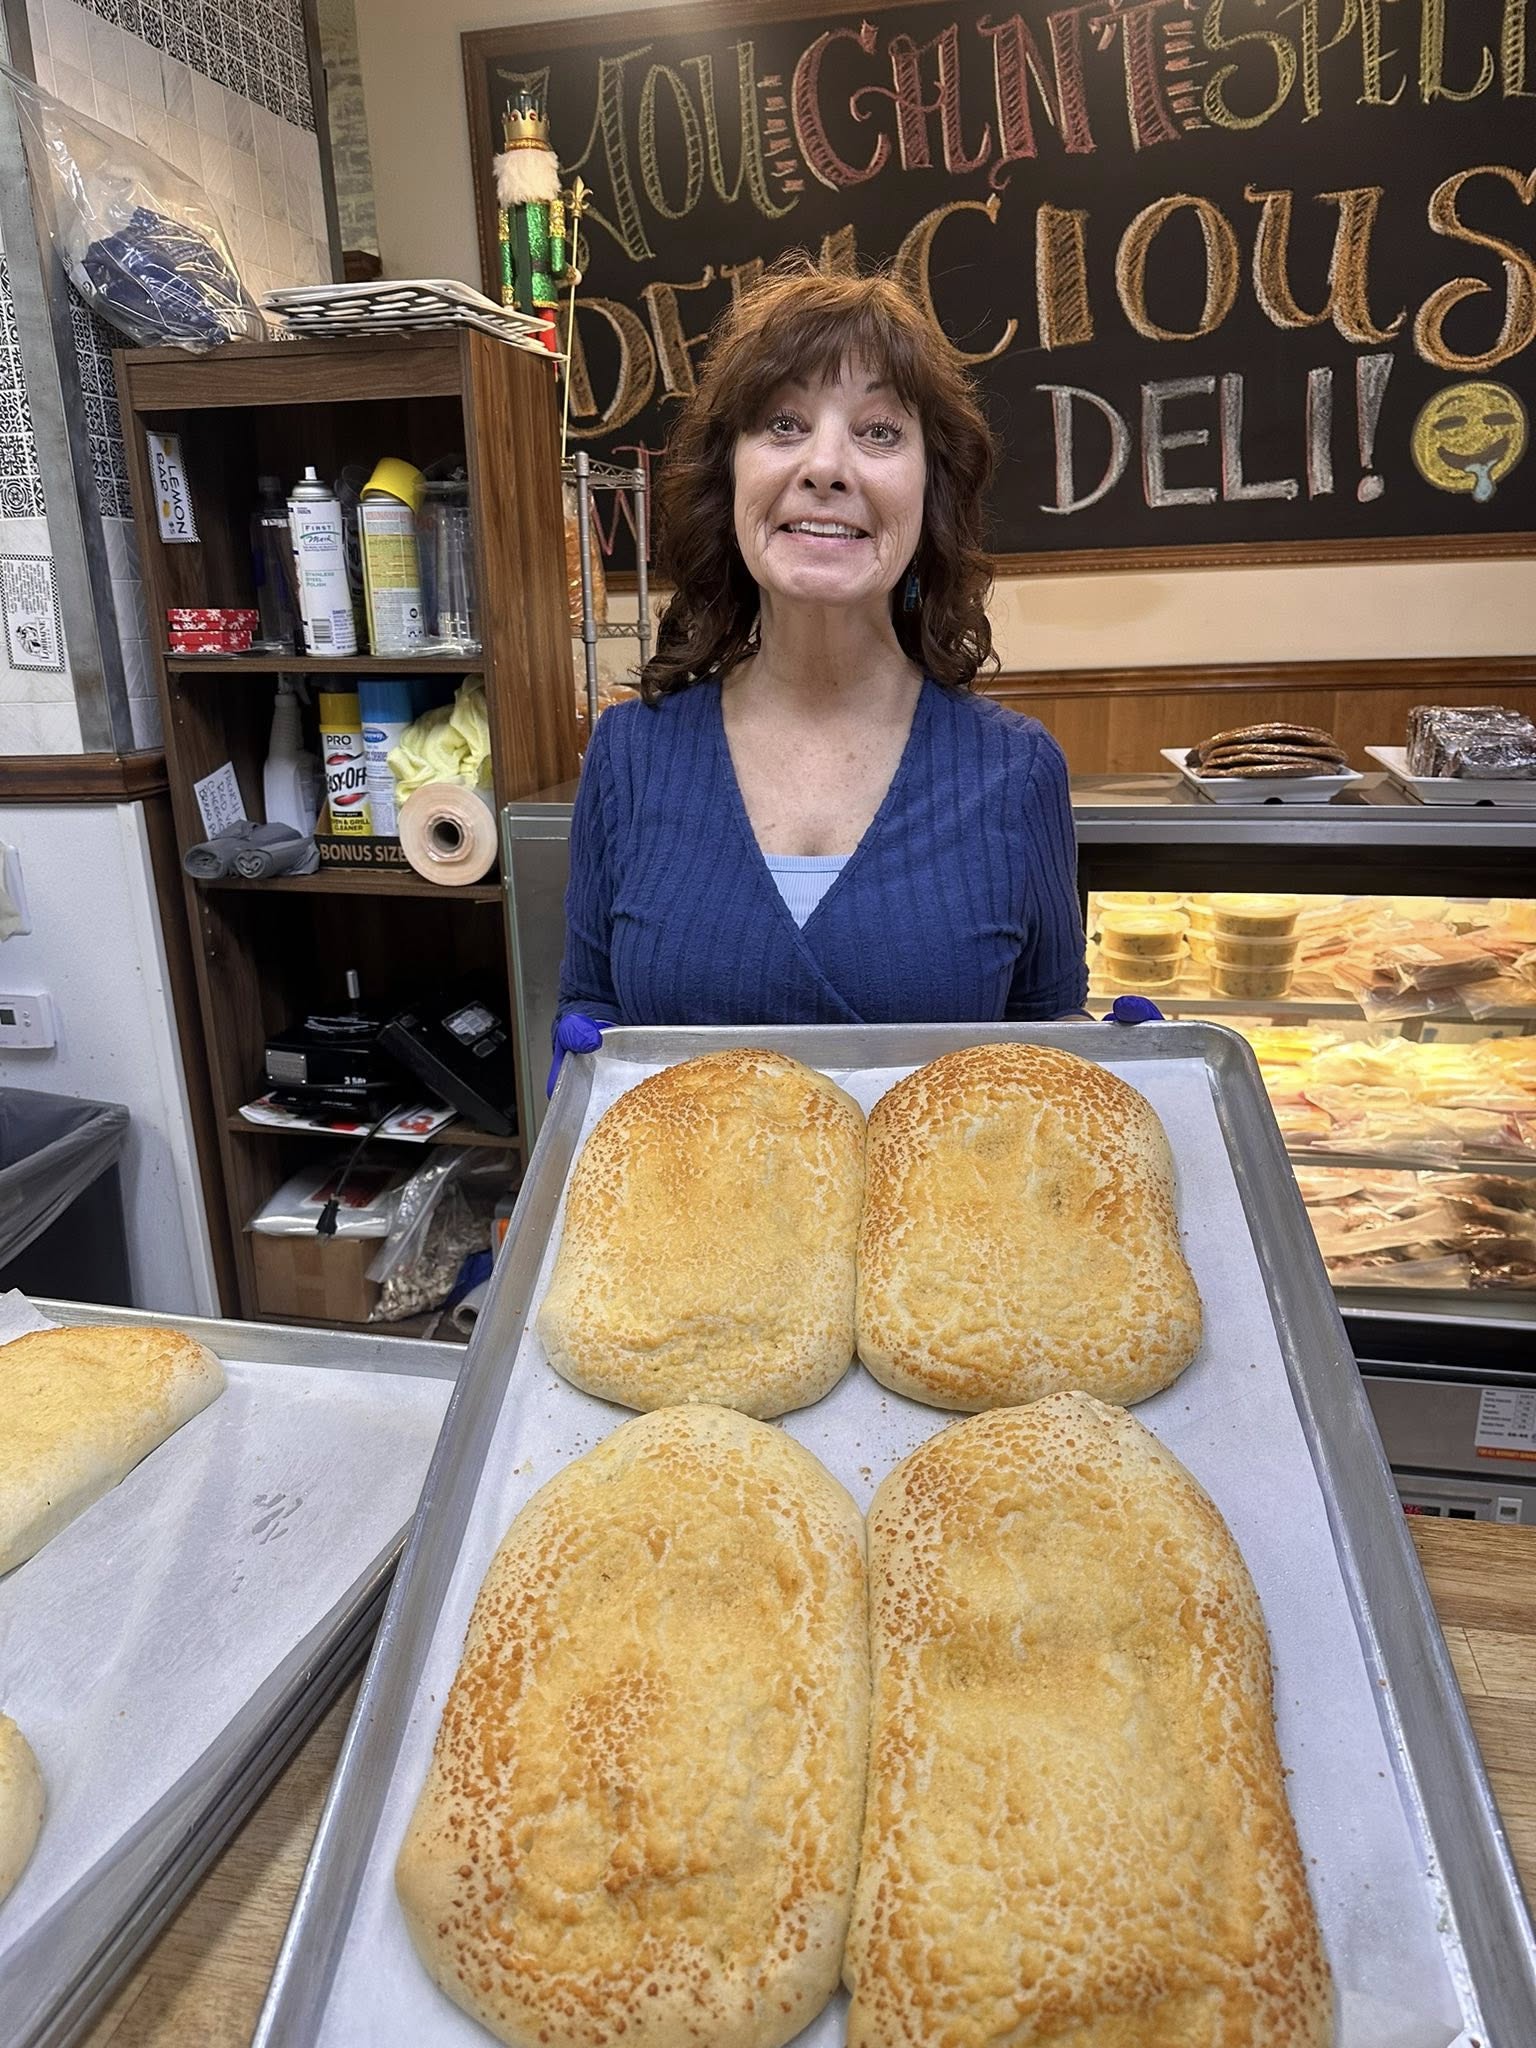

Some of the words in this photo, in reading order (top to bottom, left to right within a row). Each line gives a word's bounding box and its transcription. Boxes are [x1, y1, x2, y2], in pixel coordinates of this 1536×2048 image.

[497, 38, 801, 276] YOU
[558, 164, 1536, 440] DECIOUS
[1034, 353, 1395, 514] DELI!
[156, 452, 169, 492] BAR
[167, 465, 188, 534] LEMON
[326, 735, 352, 746] PRO
[320, 843, 373, 861] BONUS
